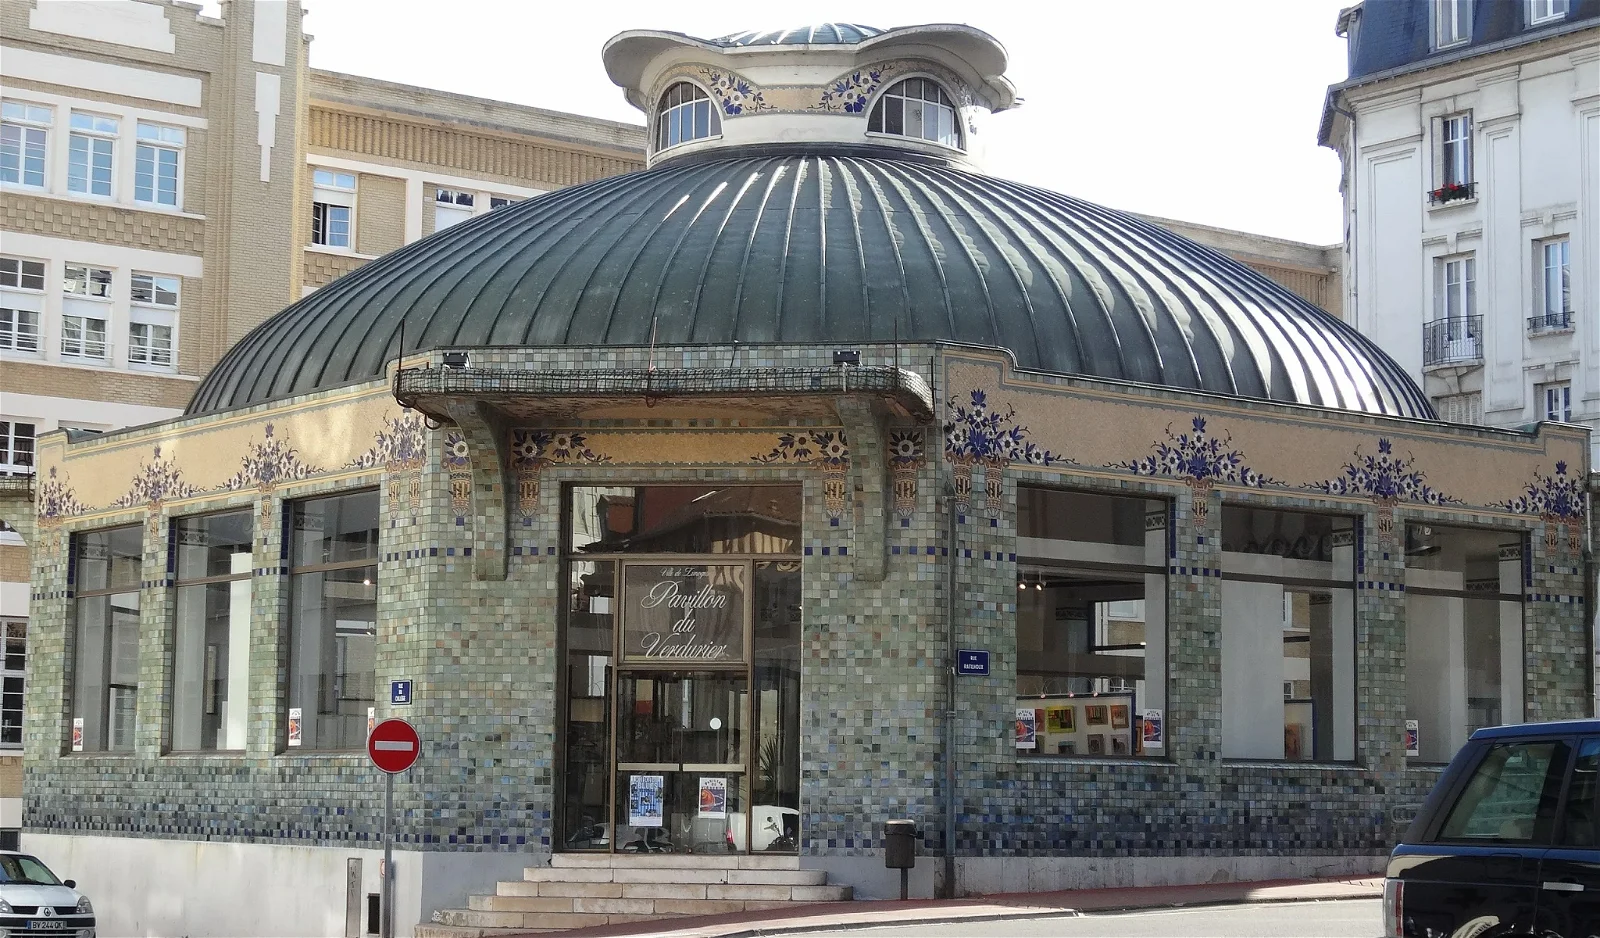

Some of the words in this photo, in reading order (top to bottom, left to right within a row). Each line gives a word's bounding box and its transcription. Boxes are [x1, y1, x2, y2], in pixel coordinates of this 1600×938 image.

[641, 580, 727, 609] Pavillon
[672, 608, 696, 633] du
[641, 632, 729, 659] Verdurier
[32, 921, 41, 929] BY
[41, 921, 54, 929] 244
